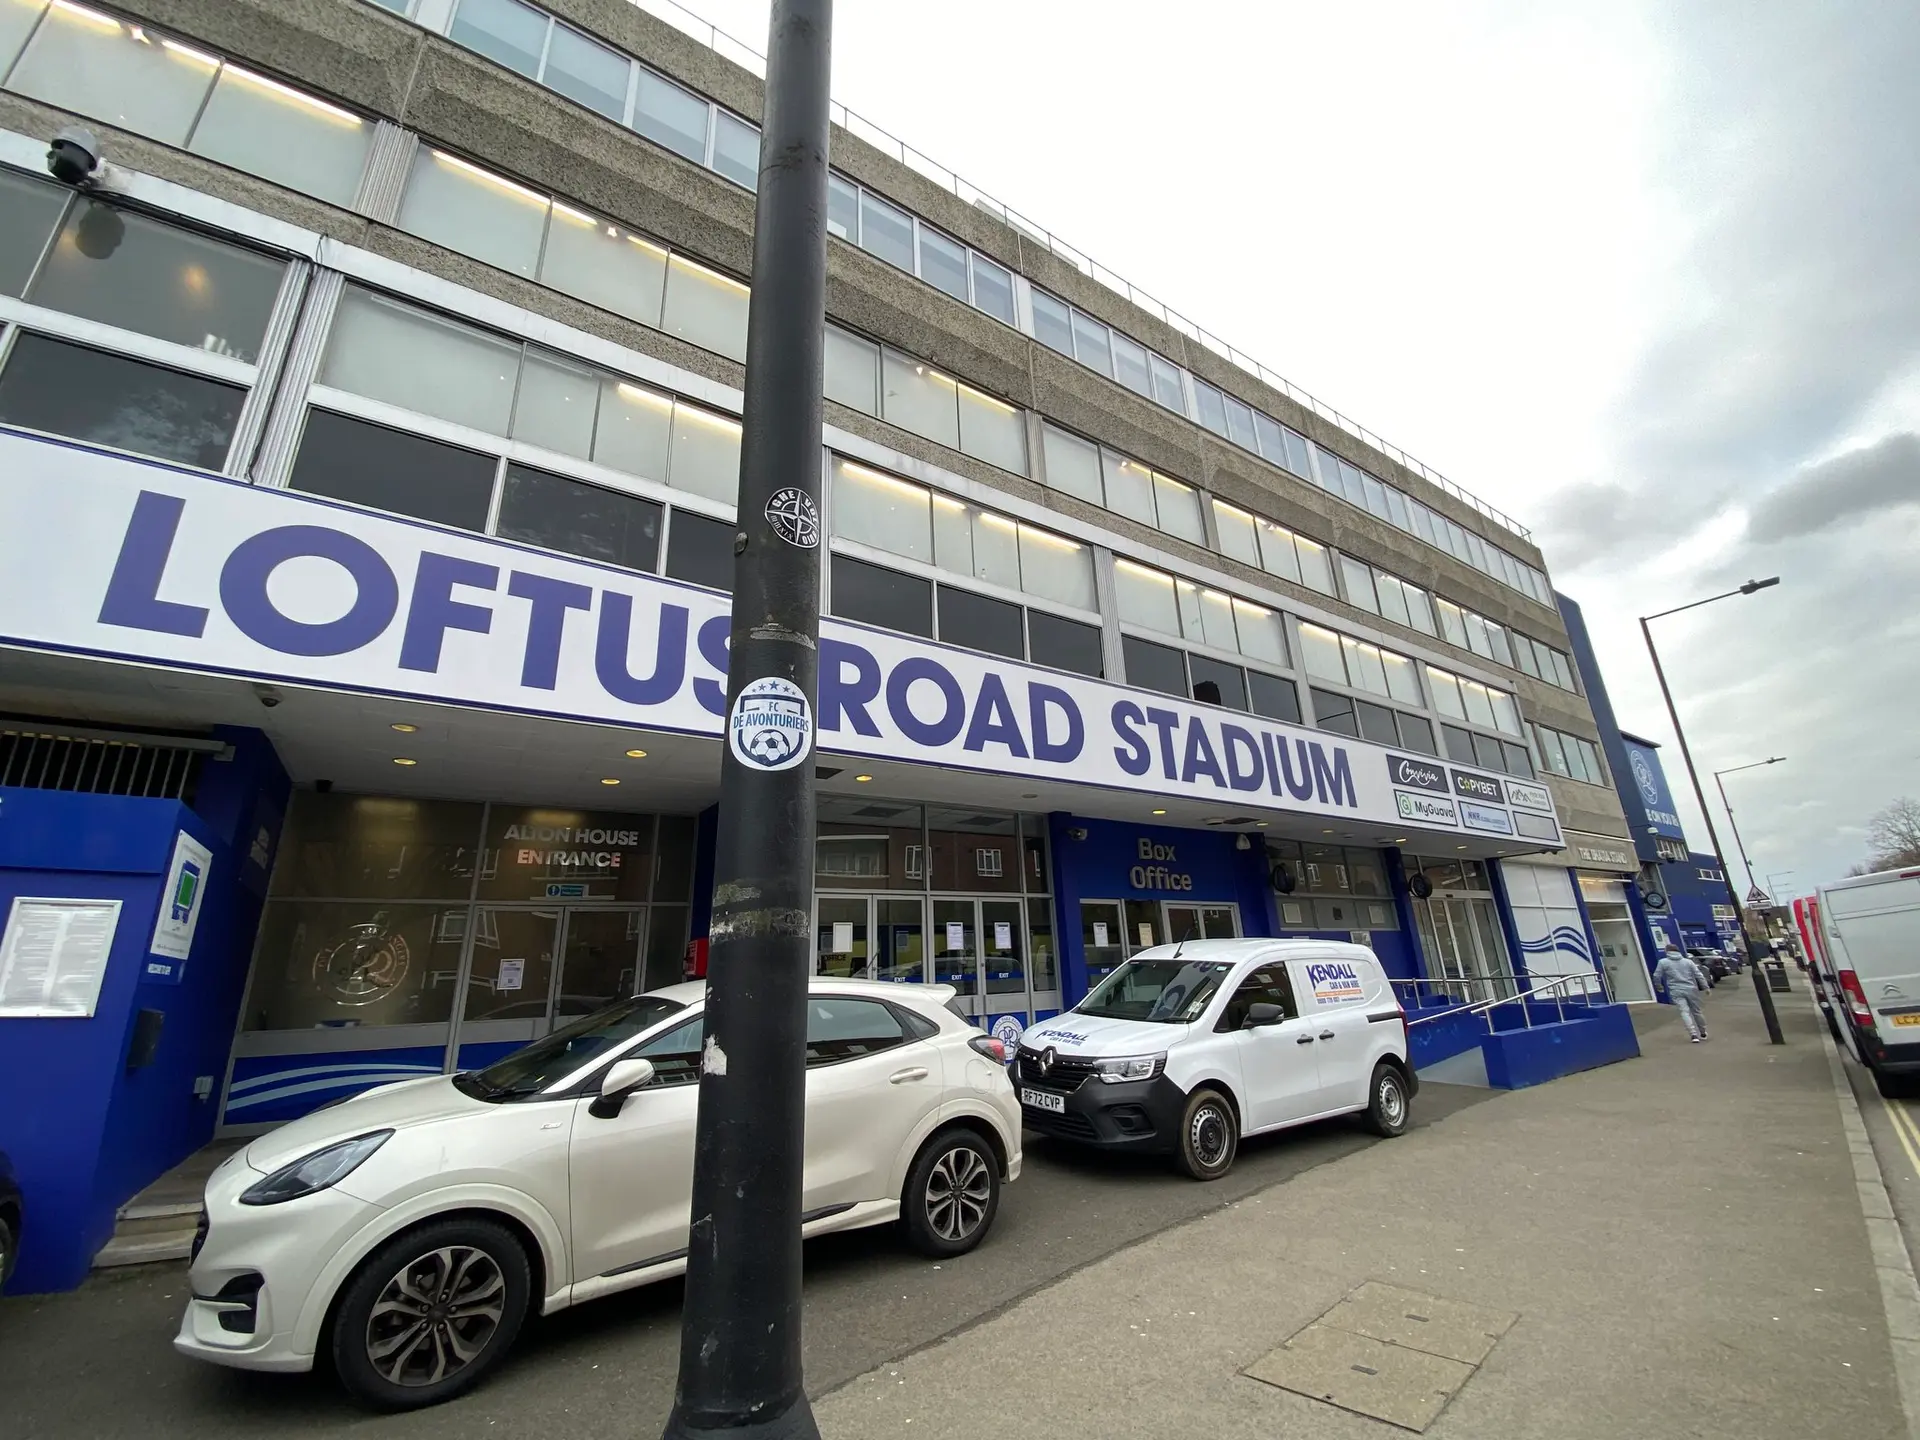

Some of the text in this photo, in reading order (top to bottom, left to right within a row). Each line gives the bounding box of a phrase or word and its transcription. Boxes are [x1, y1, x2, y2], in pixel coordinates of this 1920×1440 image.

[97, 489, 1358, 809] LOFTUS ROAD STADIUM
[768, 701, 779, 712] FC
[733, 712, 809, 733] DE AVONTURIERS
[1414, 800, 1454, 818] MyGuava
[575, 828, 640, 846] HOUSE
[517, 849, 621, 867] ENTRANCE
[1137, 837, 1177, 862] Box
[1129, 865, 1192, 891] Office
[1305, 964, 1357, 992] KENDALL
[1329, 981, 1339, 990] CAR
[1034, 1029, 1090, 1042] KENDALL
[1024, 1089, 1060, 1109] RF72 CVP
